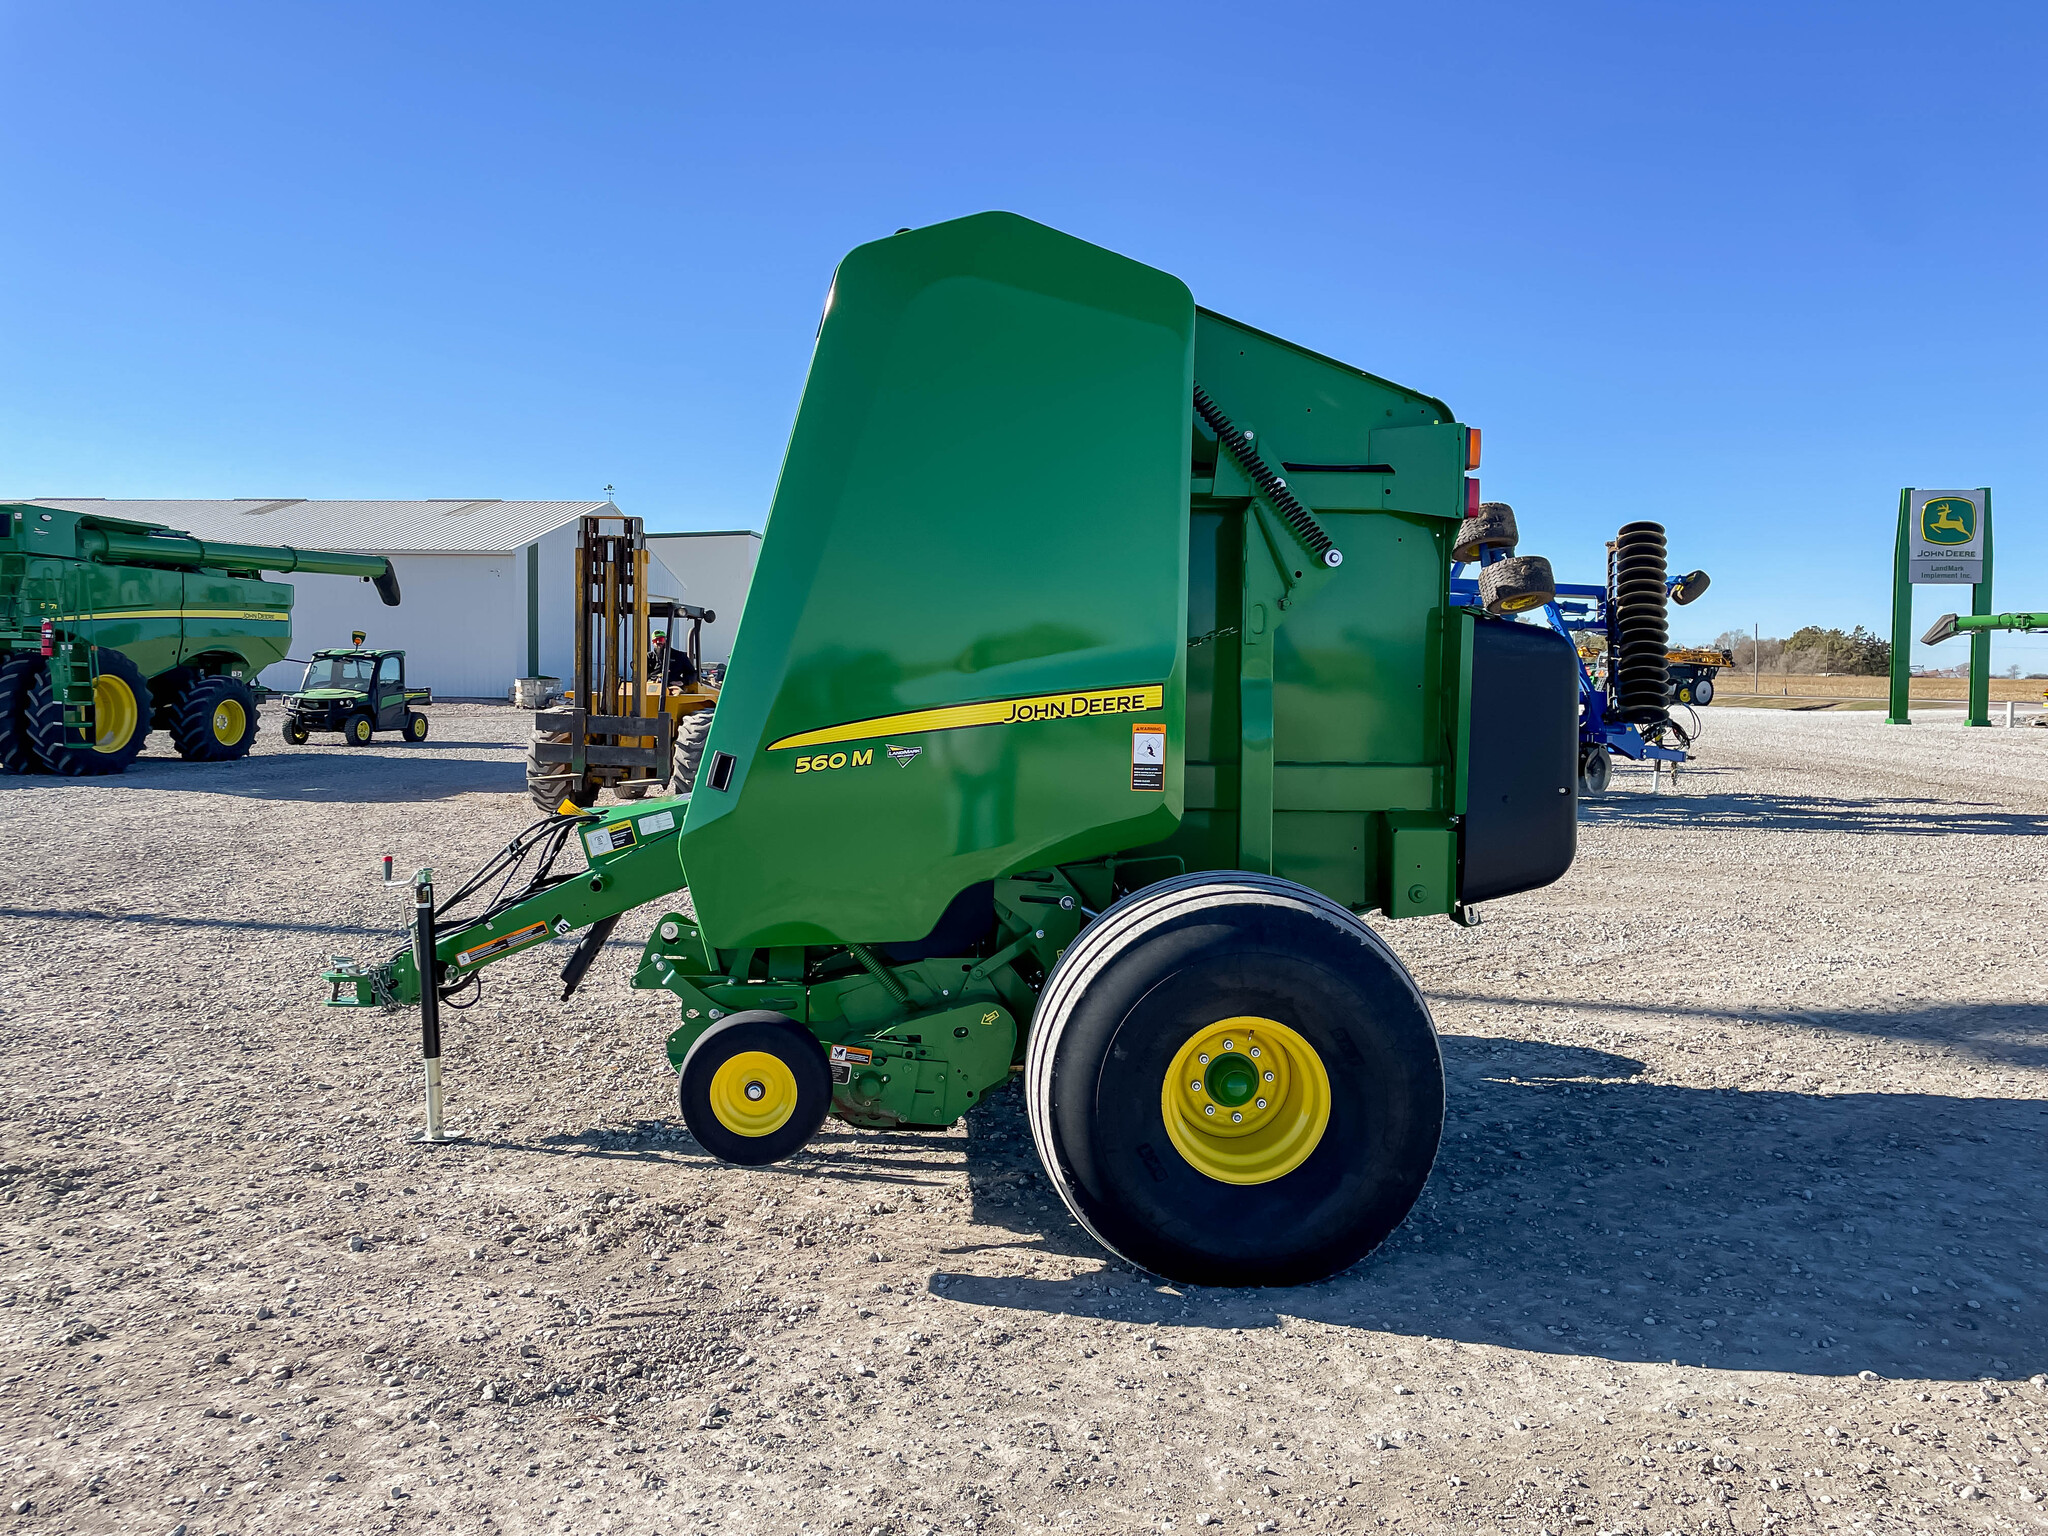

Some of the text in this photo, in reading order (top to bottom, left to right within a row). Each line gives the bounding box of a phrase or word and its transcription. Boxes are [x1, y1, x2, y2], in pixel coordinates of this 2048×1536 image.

[1917, 549, 1976, 558] JOHN DEERE
[1931, 564, 1964, 572] LandMark
[1921, 572, 1958, 580] Implement
[1004, 694, 1145, 722] JOHN DEERE
[794, 747, 874, 774] 560 M
